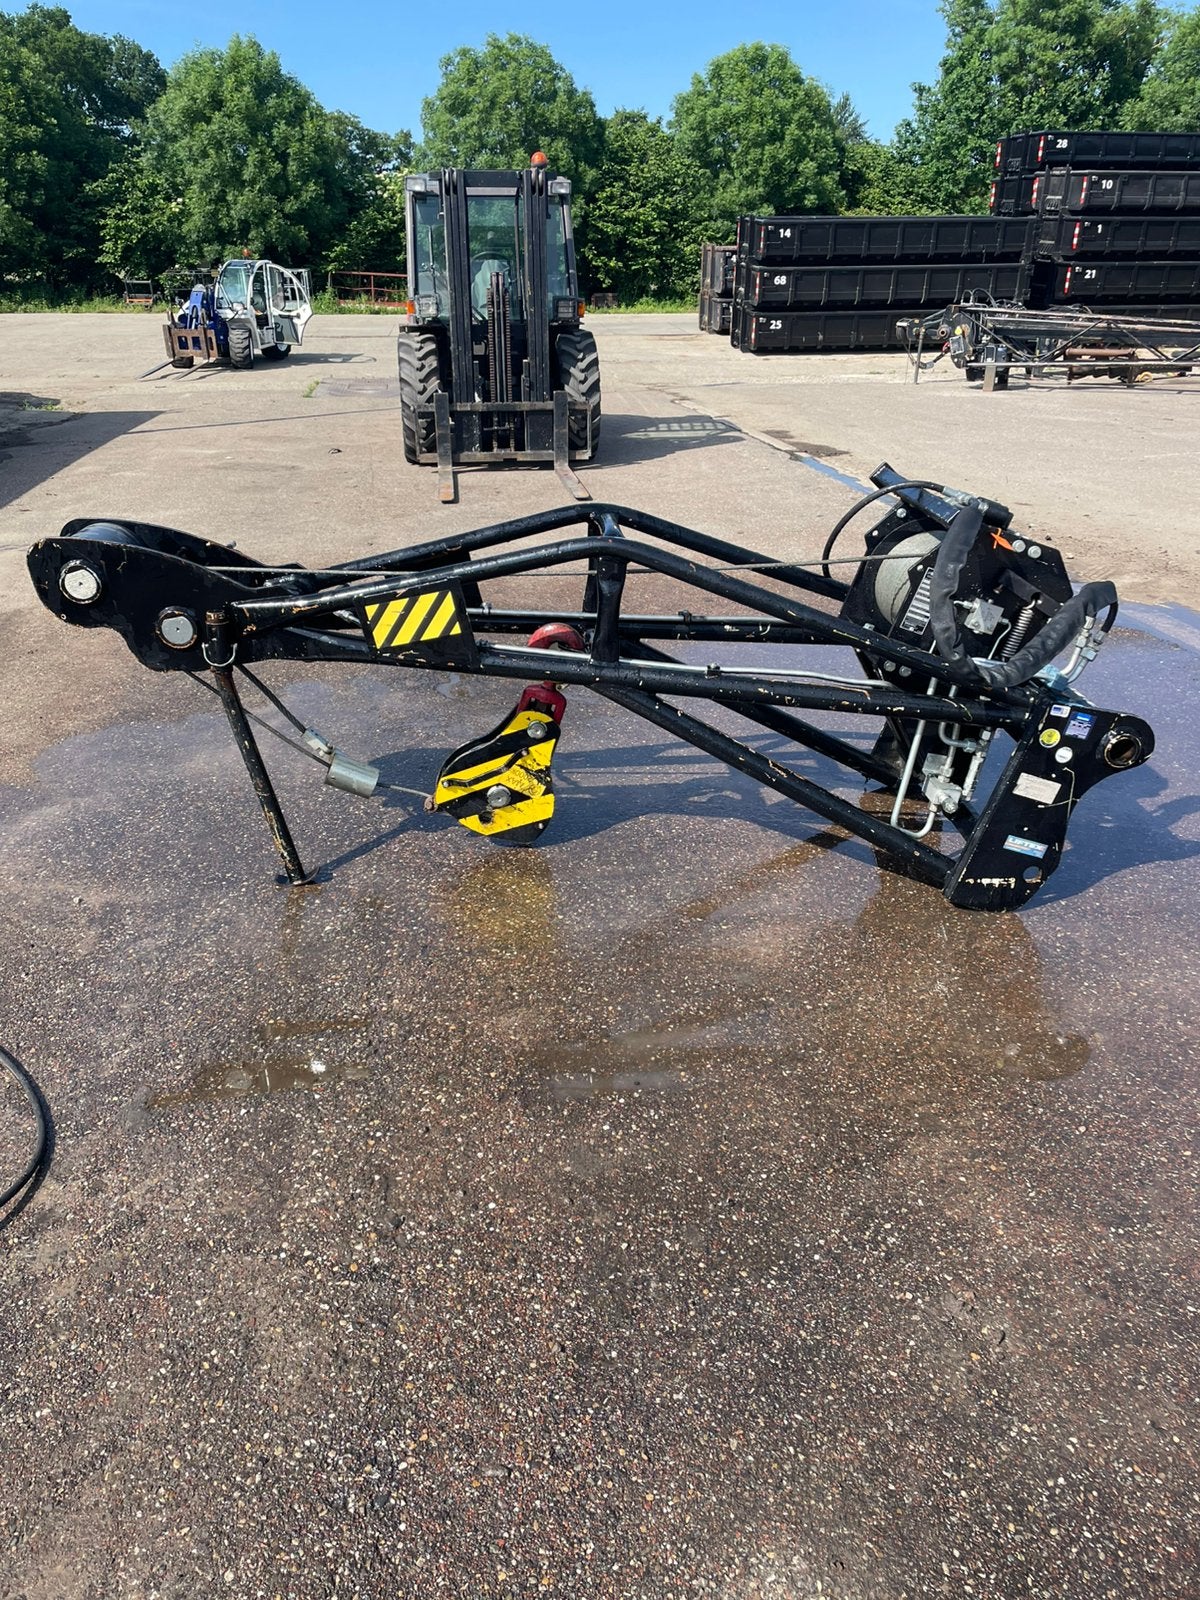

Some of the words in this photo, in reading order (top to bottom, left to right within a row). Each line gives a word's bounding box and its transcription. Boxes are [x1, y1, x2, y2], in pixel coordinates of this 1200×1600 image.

[1056, 139, 1068, 149] 28
[1101, 180, 1113, 189] 10
[779, 228, 791, 238] 14
[1097, 224, 1103, 234] 1
[1084, 269, 1096, 279] 21
[773, 275, 787, 285] 68
[769, 320, 782, 330] 25
